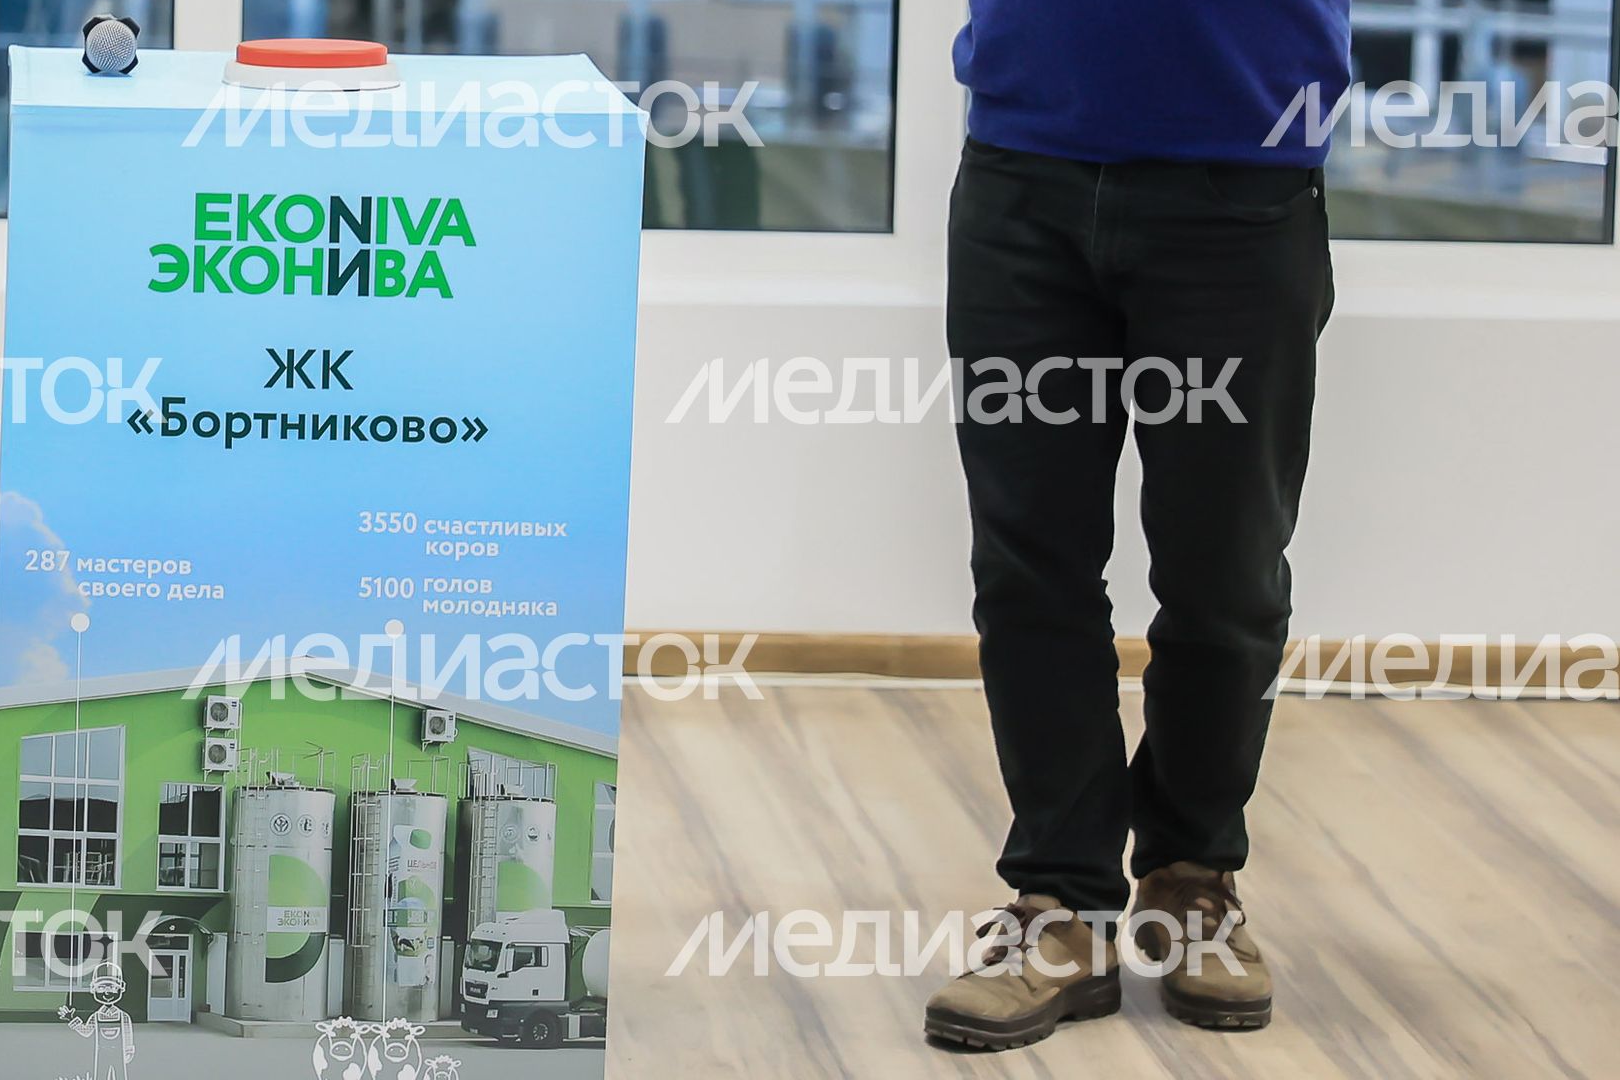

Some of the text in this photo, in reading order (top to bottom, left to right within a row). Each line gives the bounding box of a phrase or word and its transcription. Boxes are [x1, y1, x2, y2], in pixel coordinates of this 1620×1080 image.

[195, 192, 476, 246] EKONIVA
[148, 243, 453, 298] ЭКОНИВА
[263, 348, 354, 390] ЖК
[127, 397, 488, 449] «Бортниково»
[358, 511, 568, 537] 3550 счастливых
[25, 549, 192, 578] 287 мастеров
[425, 540, 500, 561] коров
[78, 581, 225, 600] своего дела
[358, 576, 493, 599] 5100 голов
[423, 599, 559, 617] молодняка
